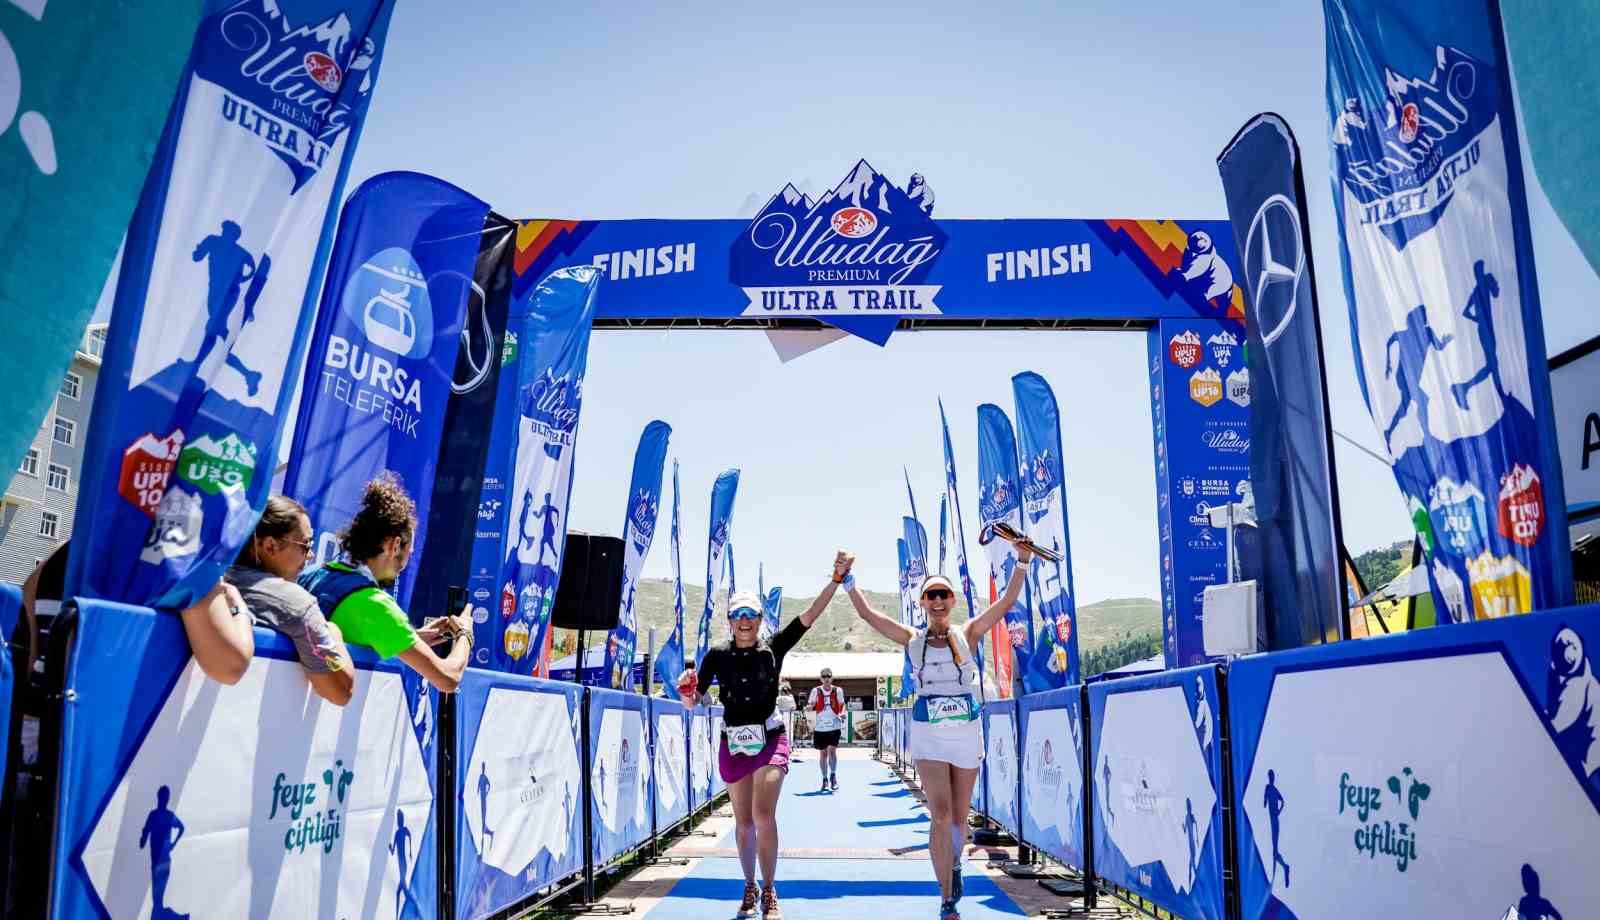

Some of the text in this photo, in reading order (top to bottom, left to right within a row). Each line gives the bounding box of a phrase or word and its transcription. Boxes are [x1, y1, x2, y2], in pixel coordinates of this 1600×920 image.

[222, 94, 300, 153] ULTRA
[593, 242, 696, 282] FINISH
[751, 211, 942, 287] Uludağ
[986, 242, 1092, 283] FINISH
[761, 289, 923, 311] ULTRA TRAIL
[808, 269, 881, 282] PREMIUM
[324, 333, 422, 414] BURSA
[321, 370, 421, 440] TELEFERİK
[269, 772, 316, 821] feyz
[1338, 771, 1382, 822] feyz
[284, 808, 341, 854] çiftliği
[1353, 820, 1417, 873] çiftliği
